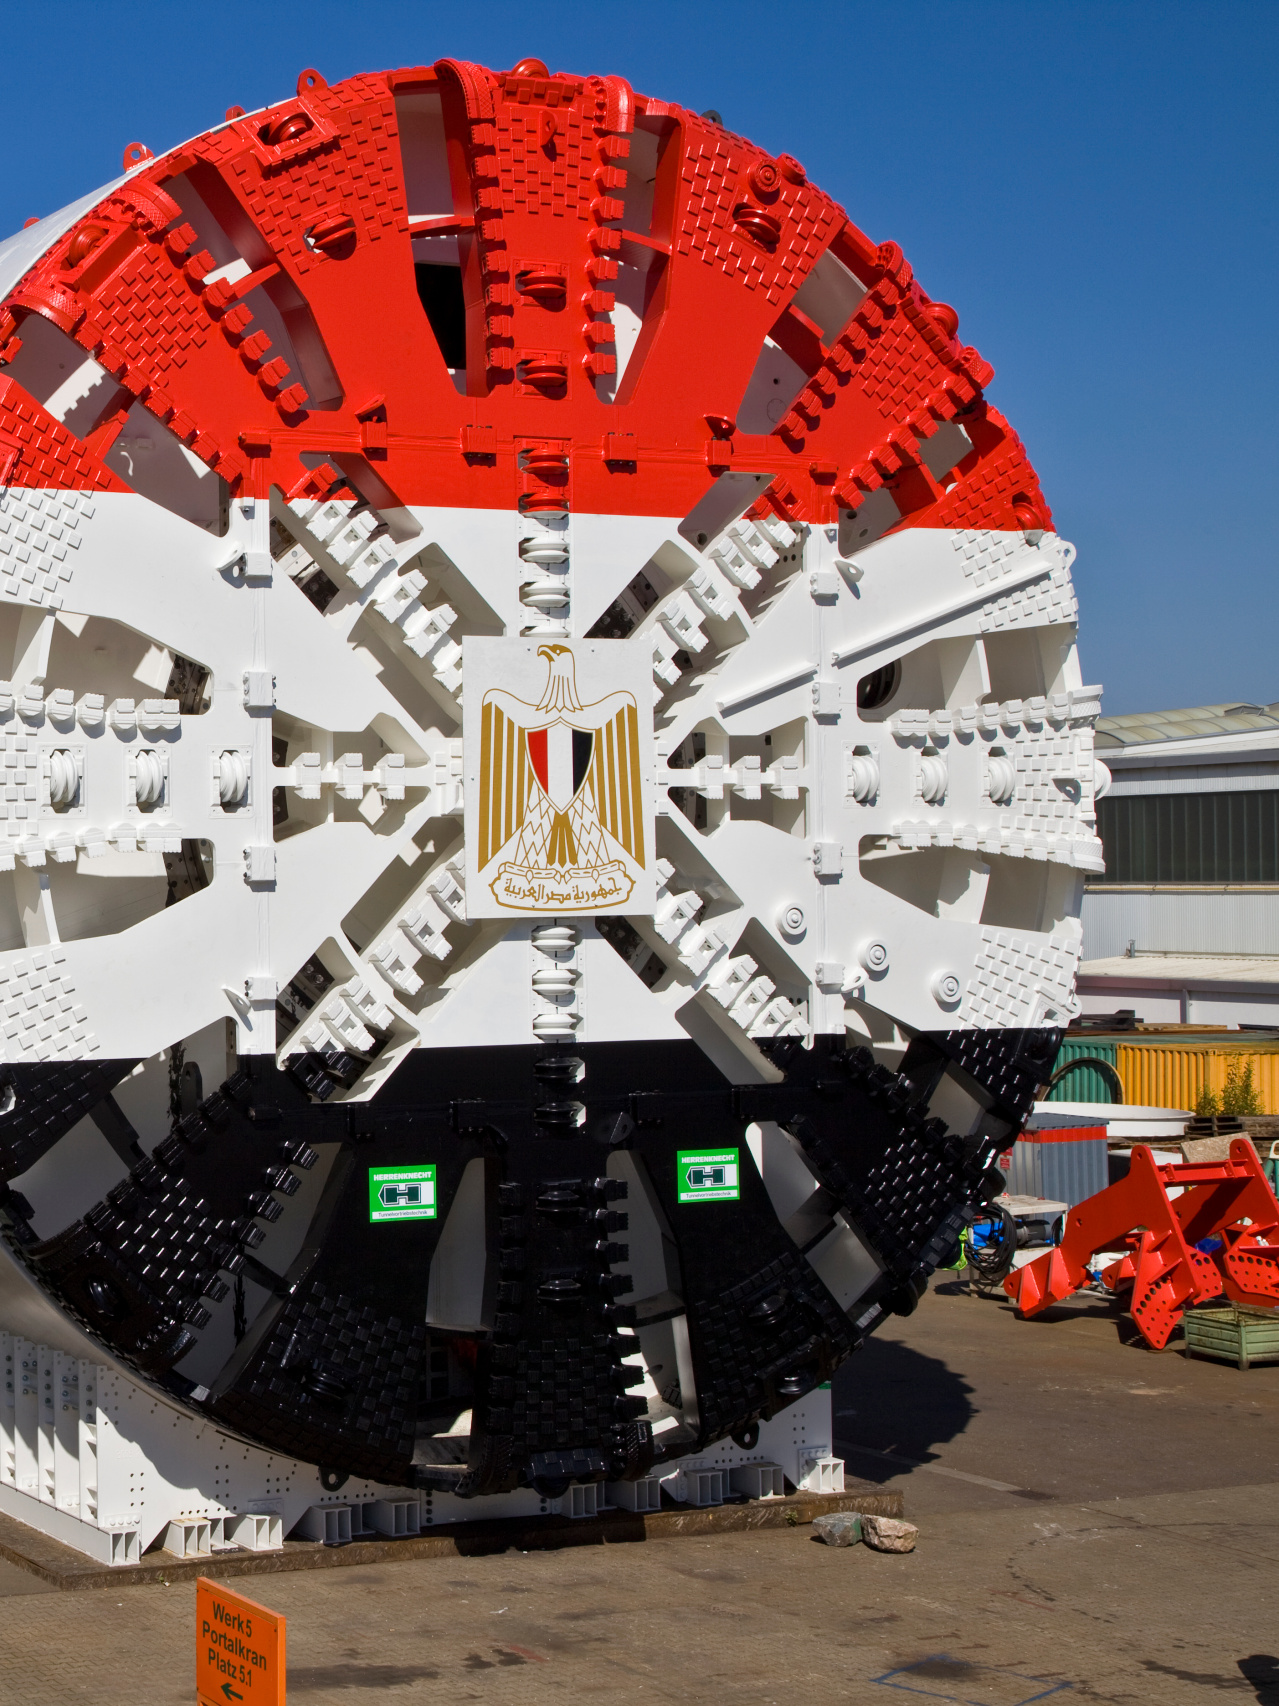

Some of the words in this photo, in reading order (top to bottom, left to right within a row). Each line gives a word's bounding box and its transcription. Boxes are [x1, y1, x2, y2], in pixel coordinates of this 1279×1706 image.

[504, 877, 545, 902] العربية
[543, 890, 571, 904] مصر
[572, 877, 623, 904] جمهورية
[681, 1154, 735, 1164] HERRENKNECHT
[373, 1171, 432, 1181] HERRENKNECHT
[212, 1600, 245, 1635] Werk
[245, 1618, 252, 1638] 5
[202, 1620, 267, 1671] Portalkran
[208, 1647, 237, 1680] Platz
[239, 1664, 252, 1688] 5.1
